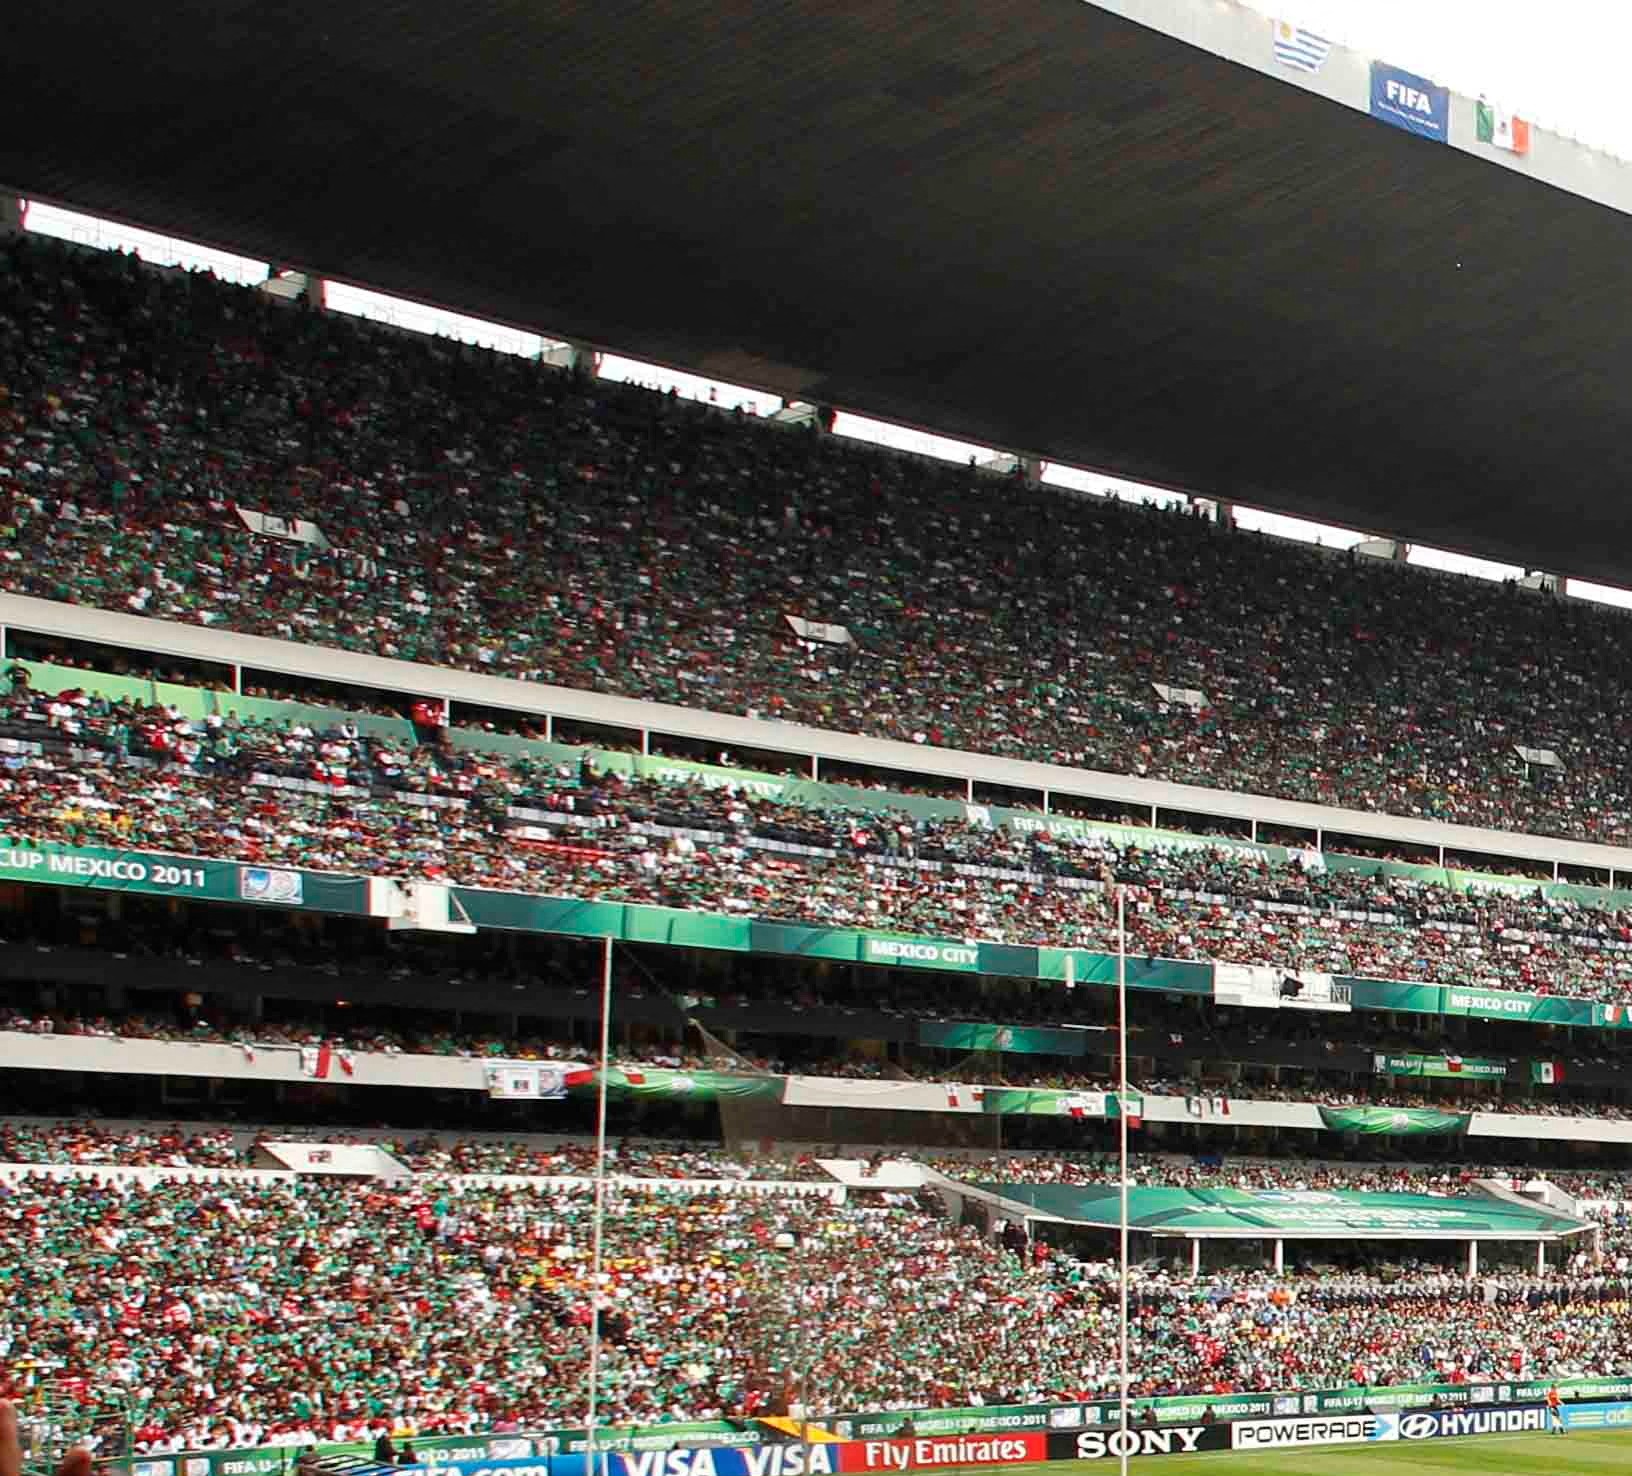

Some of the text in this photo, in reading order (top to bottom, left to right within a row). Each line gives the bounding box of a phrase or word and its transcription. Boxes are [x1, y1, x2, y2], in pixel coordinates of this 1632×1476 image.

[1386, 79, 1431, 114] FIFA
[50, 854, 146, 881] MEXICO
[152, 865, 205, 887] 2011
[871, 940, 979, 963] MEXICO CITY
[1451, 994, 1532, 1012] MEXICO CITY
[1447, 1392, 1467, 1402] 2011
[861, 1423, 887, 1435] FIFA
[1022, 1414, 1047, 1425] 2011
[1238, 1420, 1377, 1444] POWERADE
[1441, 1408, 1544, 1435] HYUNDAI
[865, 1438, 1026, 1469] Fly Emirates
[1077, 1427, 1206, 1458] SONY
[223, 1461, 258, 1475] FIFA
[739, 1445, 832, 1476] VISA
